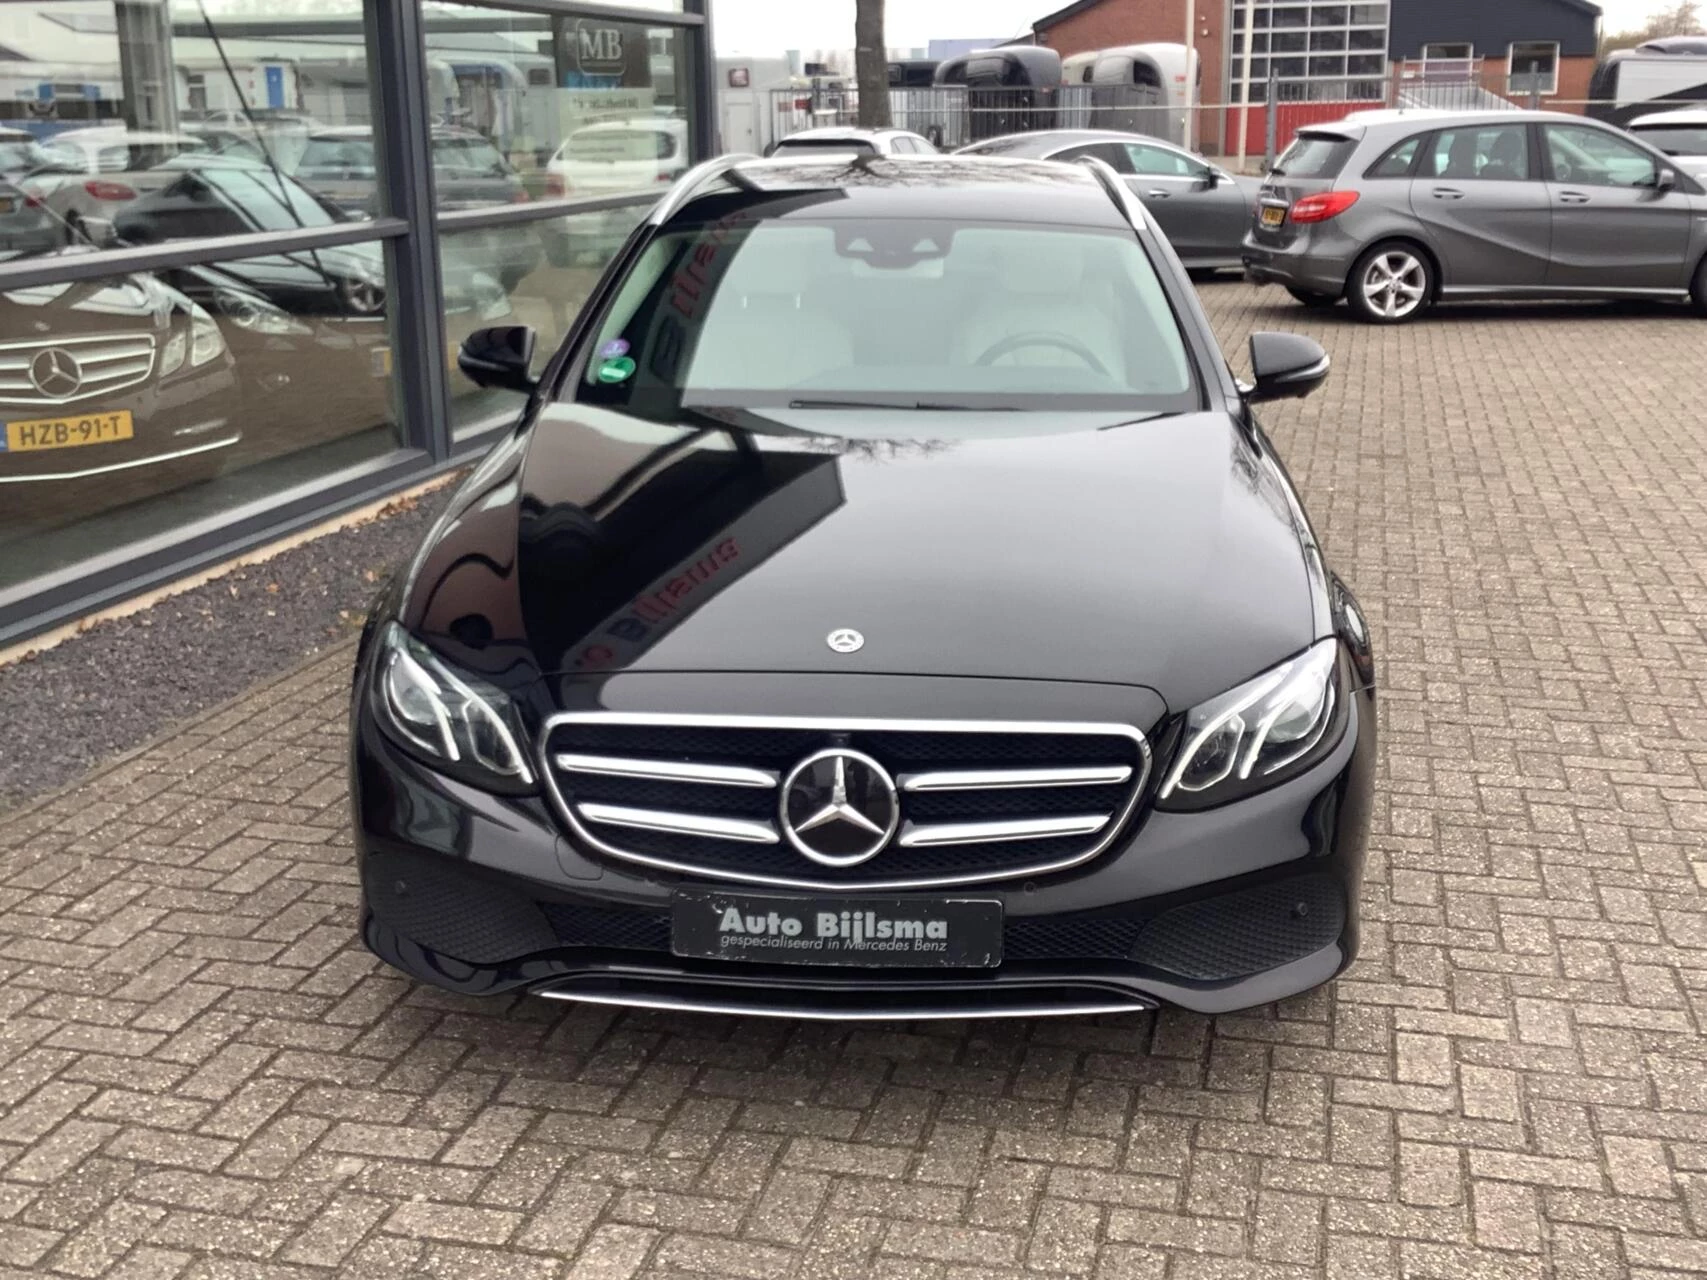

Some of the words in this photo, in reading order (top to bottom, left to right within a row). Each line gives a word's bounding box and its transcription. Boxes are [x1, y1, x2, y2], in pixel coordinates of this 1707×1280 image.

[579, 27, 623, 60] MB
[19, 415, 120, 446] HZB-91-T
[719, 907, 802, 936] Auto
[817, 911, 948, 945] Bijlsma
[720, 933, 824, 951] gespecialiseerd
[828, 937, 840, 950] in
[844, 938, 910, 952] Mercedes
[914, 939, 948, 952] Benz
